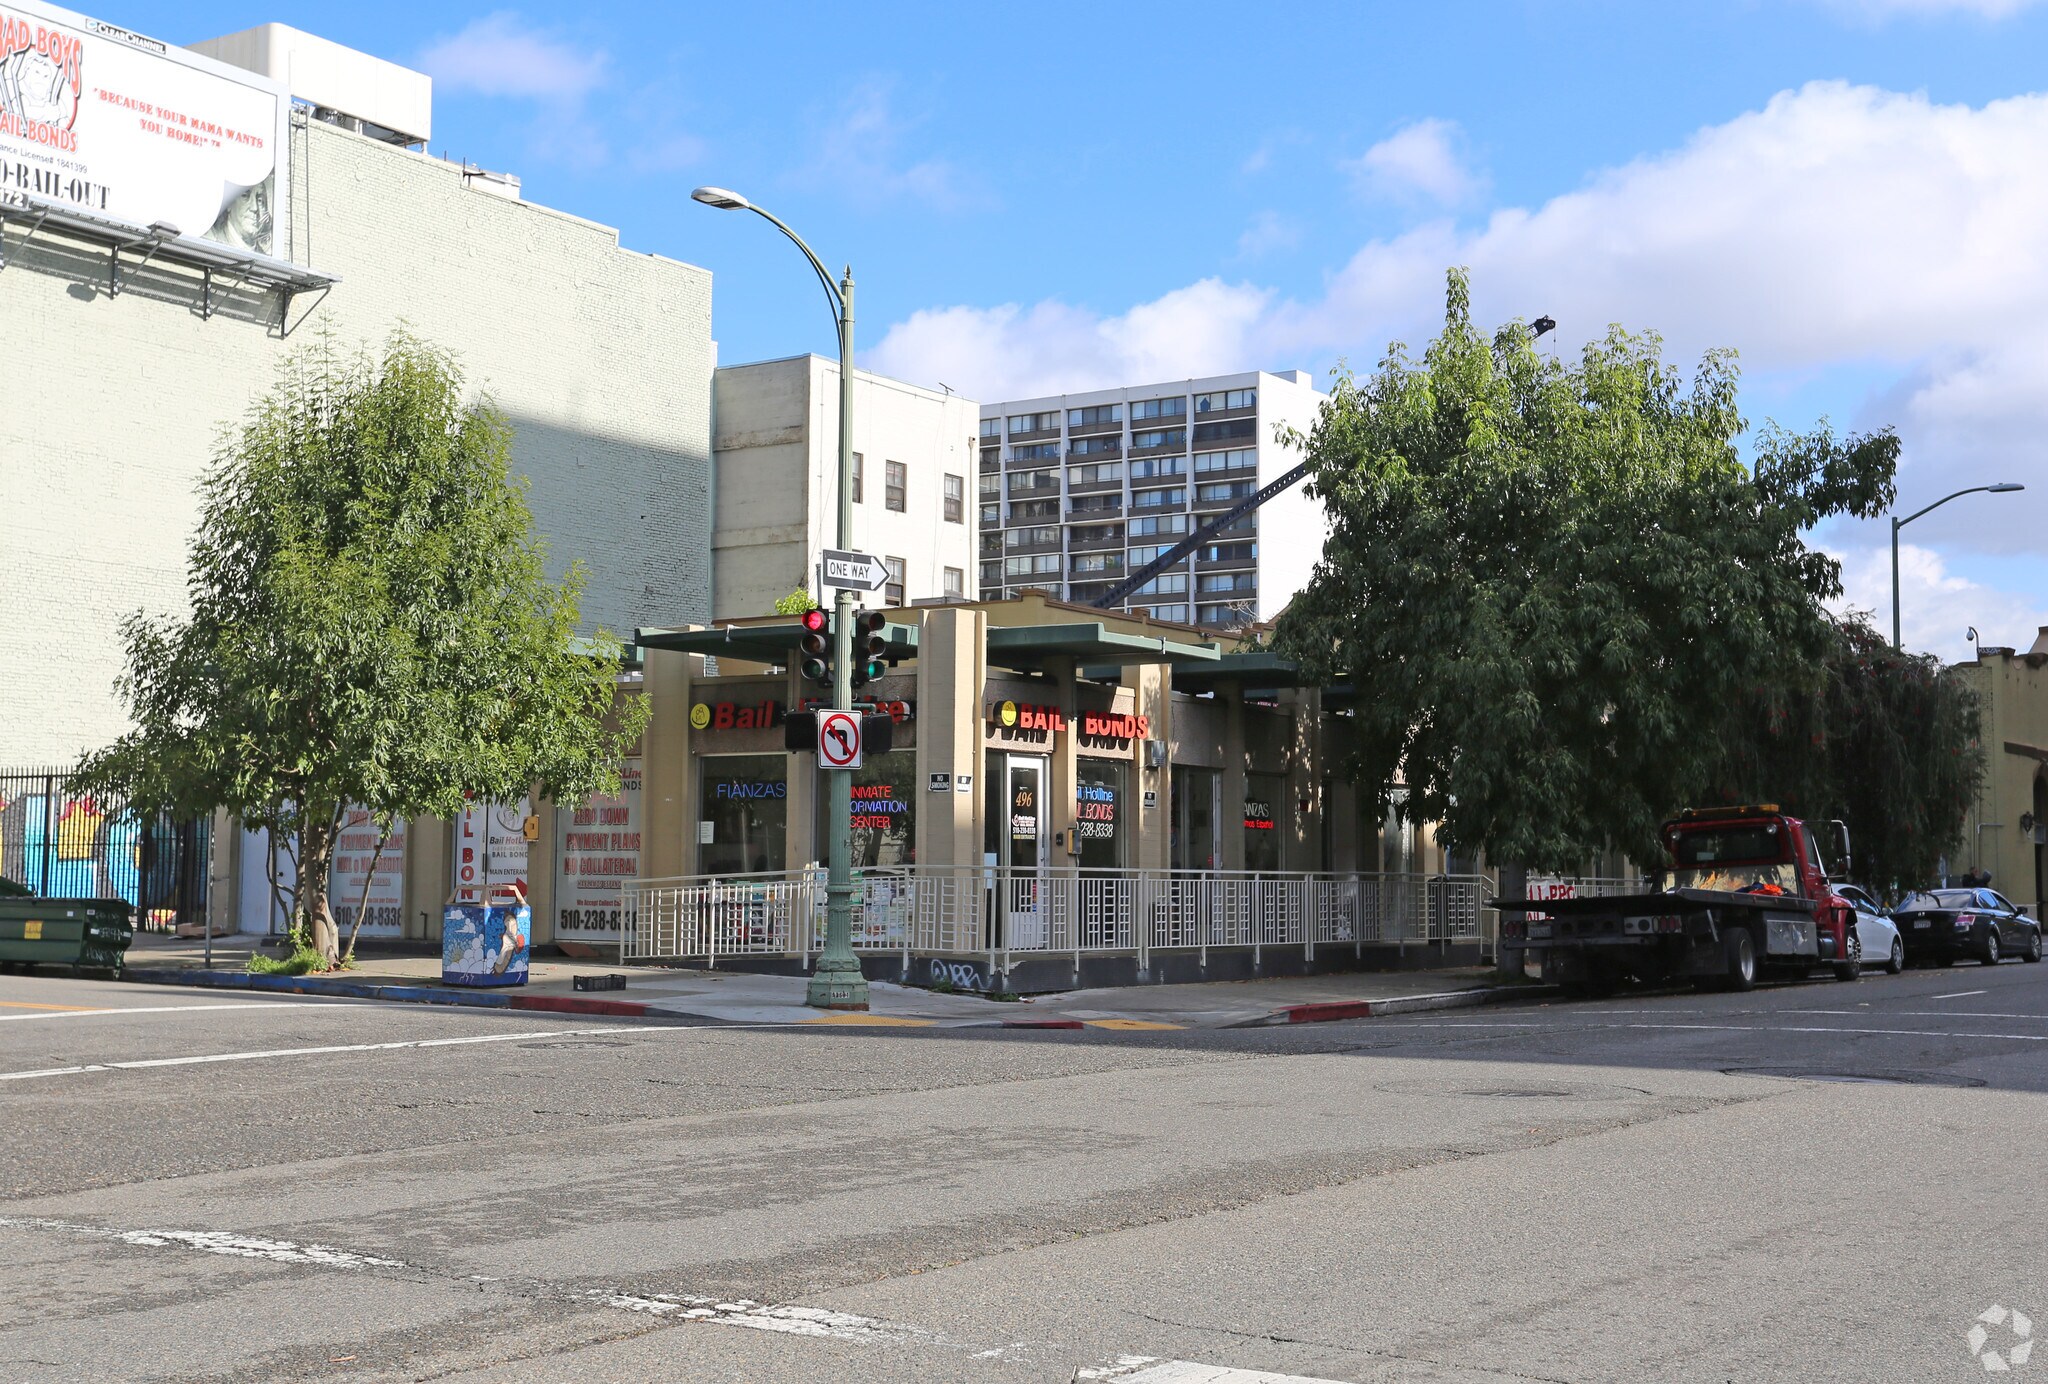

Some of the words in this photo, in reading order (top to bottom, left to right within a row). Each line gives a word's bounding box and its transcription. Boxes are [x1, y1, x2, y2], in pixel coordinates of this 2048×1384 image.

[0, 14, 31, 59] AD
[36, 26, 81, 97] BOYS
[0, 112, 22, 138] AIL
[28, 119, 77, 153] BONDS
[139, 118, 163, 134] YOU
[156, 106, 187, 125] YOUR
[190, 117, 223, 137] MAMA
[225, 128, 263, 149] WANTS
[830, 562, 848, 577] ONE
[851, 564, 870, 579] WAY
[714, 700, 774, 730] Bail
[1020, 703, 1066, 732] BAIL
[1085, 709, 1149, 740] BONDS
[717, 783, 786, 798] FIANZAS
[851, 786, 892, 798] INMATE
[851, 800, 907, 812] ORMATION
[1016, 792, 1032, 807] 496
[573, 808, 597, 826] ZERO
[600, 808, 629, 826] DOWN
[1084, 803, 1114, 820] BONDS
[489, 836, 504, 845] Bail
[566, 832, 608, 850] PAYMENT
[611, 834, 641, 850] PLANS
[564, 857, 577, 875] NO
[579, 857, 637, 875] COLLATERAL
